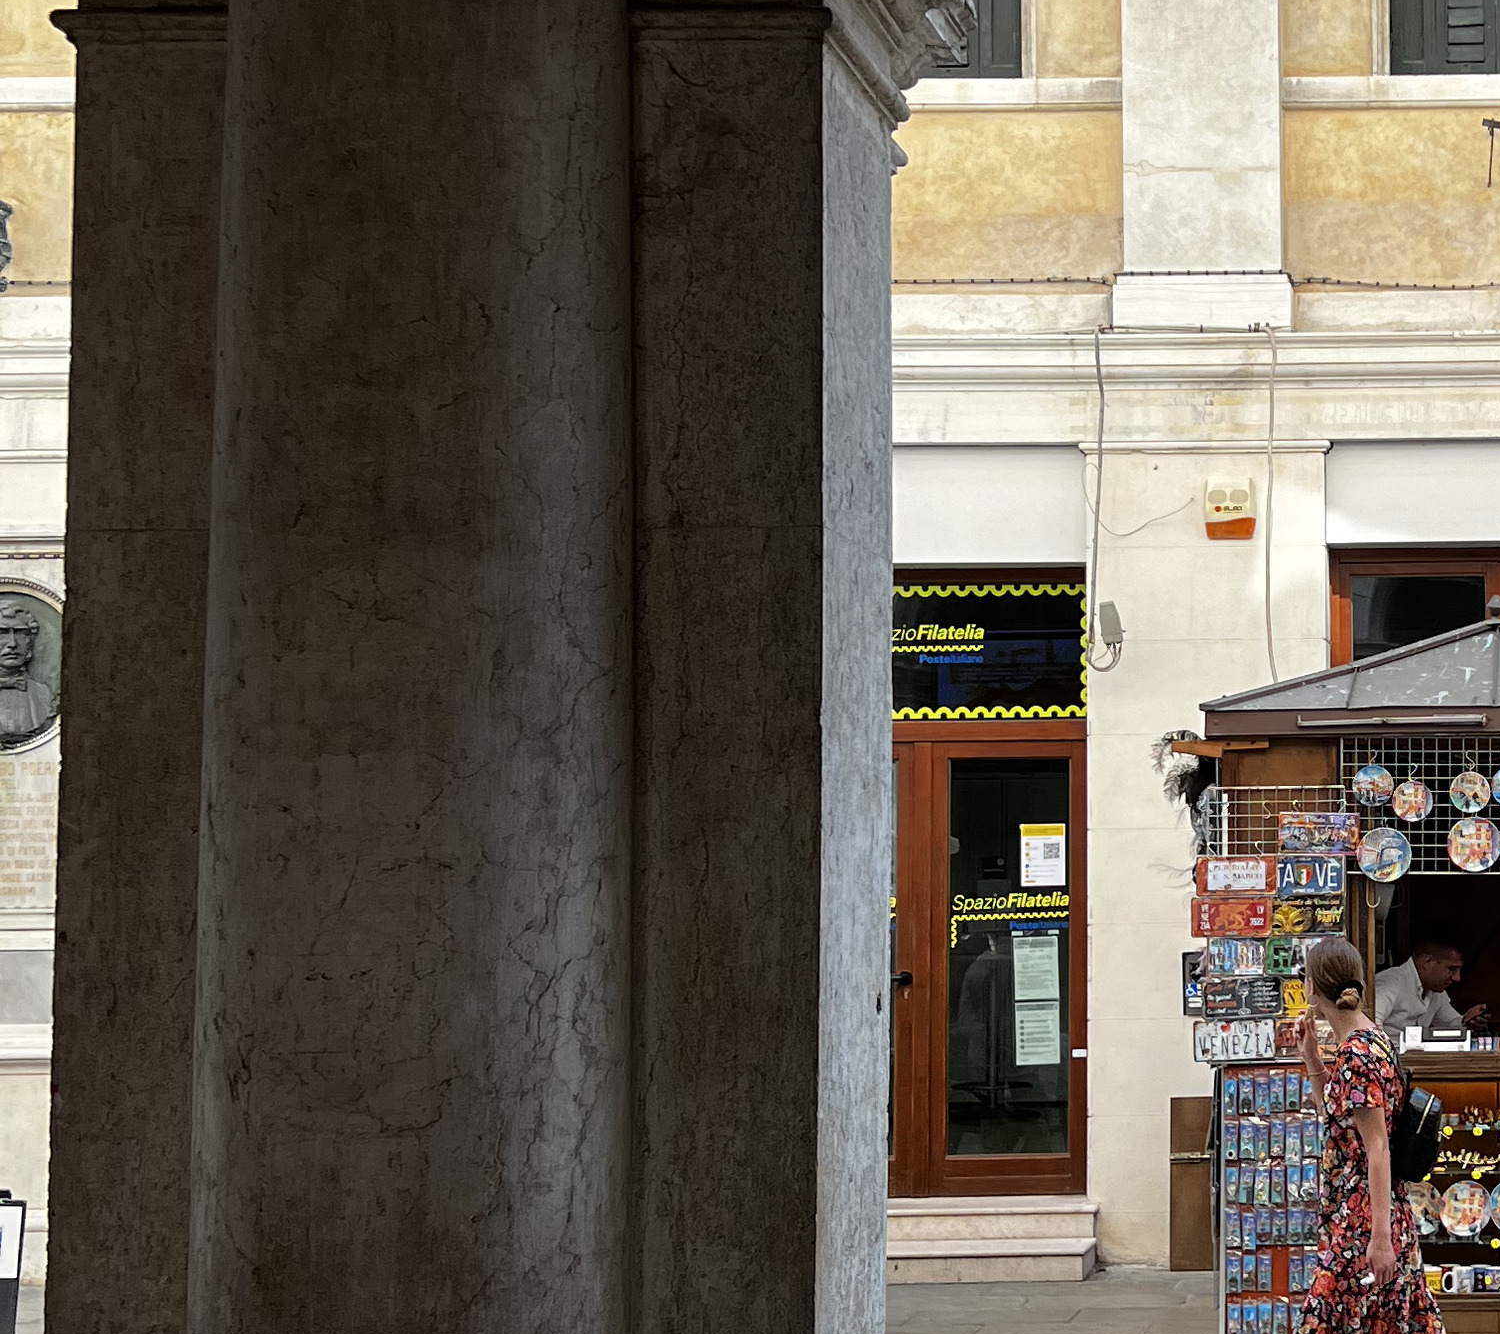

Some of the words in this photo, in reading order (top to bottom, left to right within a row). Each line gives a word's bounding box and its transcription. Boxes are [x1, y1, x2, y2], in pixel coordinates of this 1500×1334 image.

[892, 623, 985, 641] zioFilatelia
[951, 891, 1070, 914] SpazioFilatelia
[1198, 1032, 1274, 1056] VENEZIA
